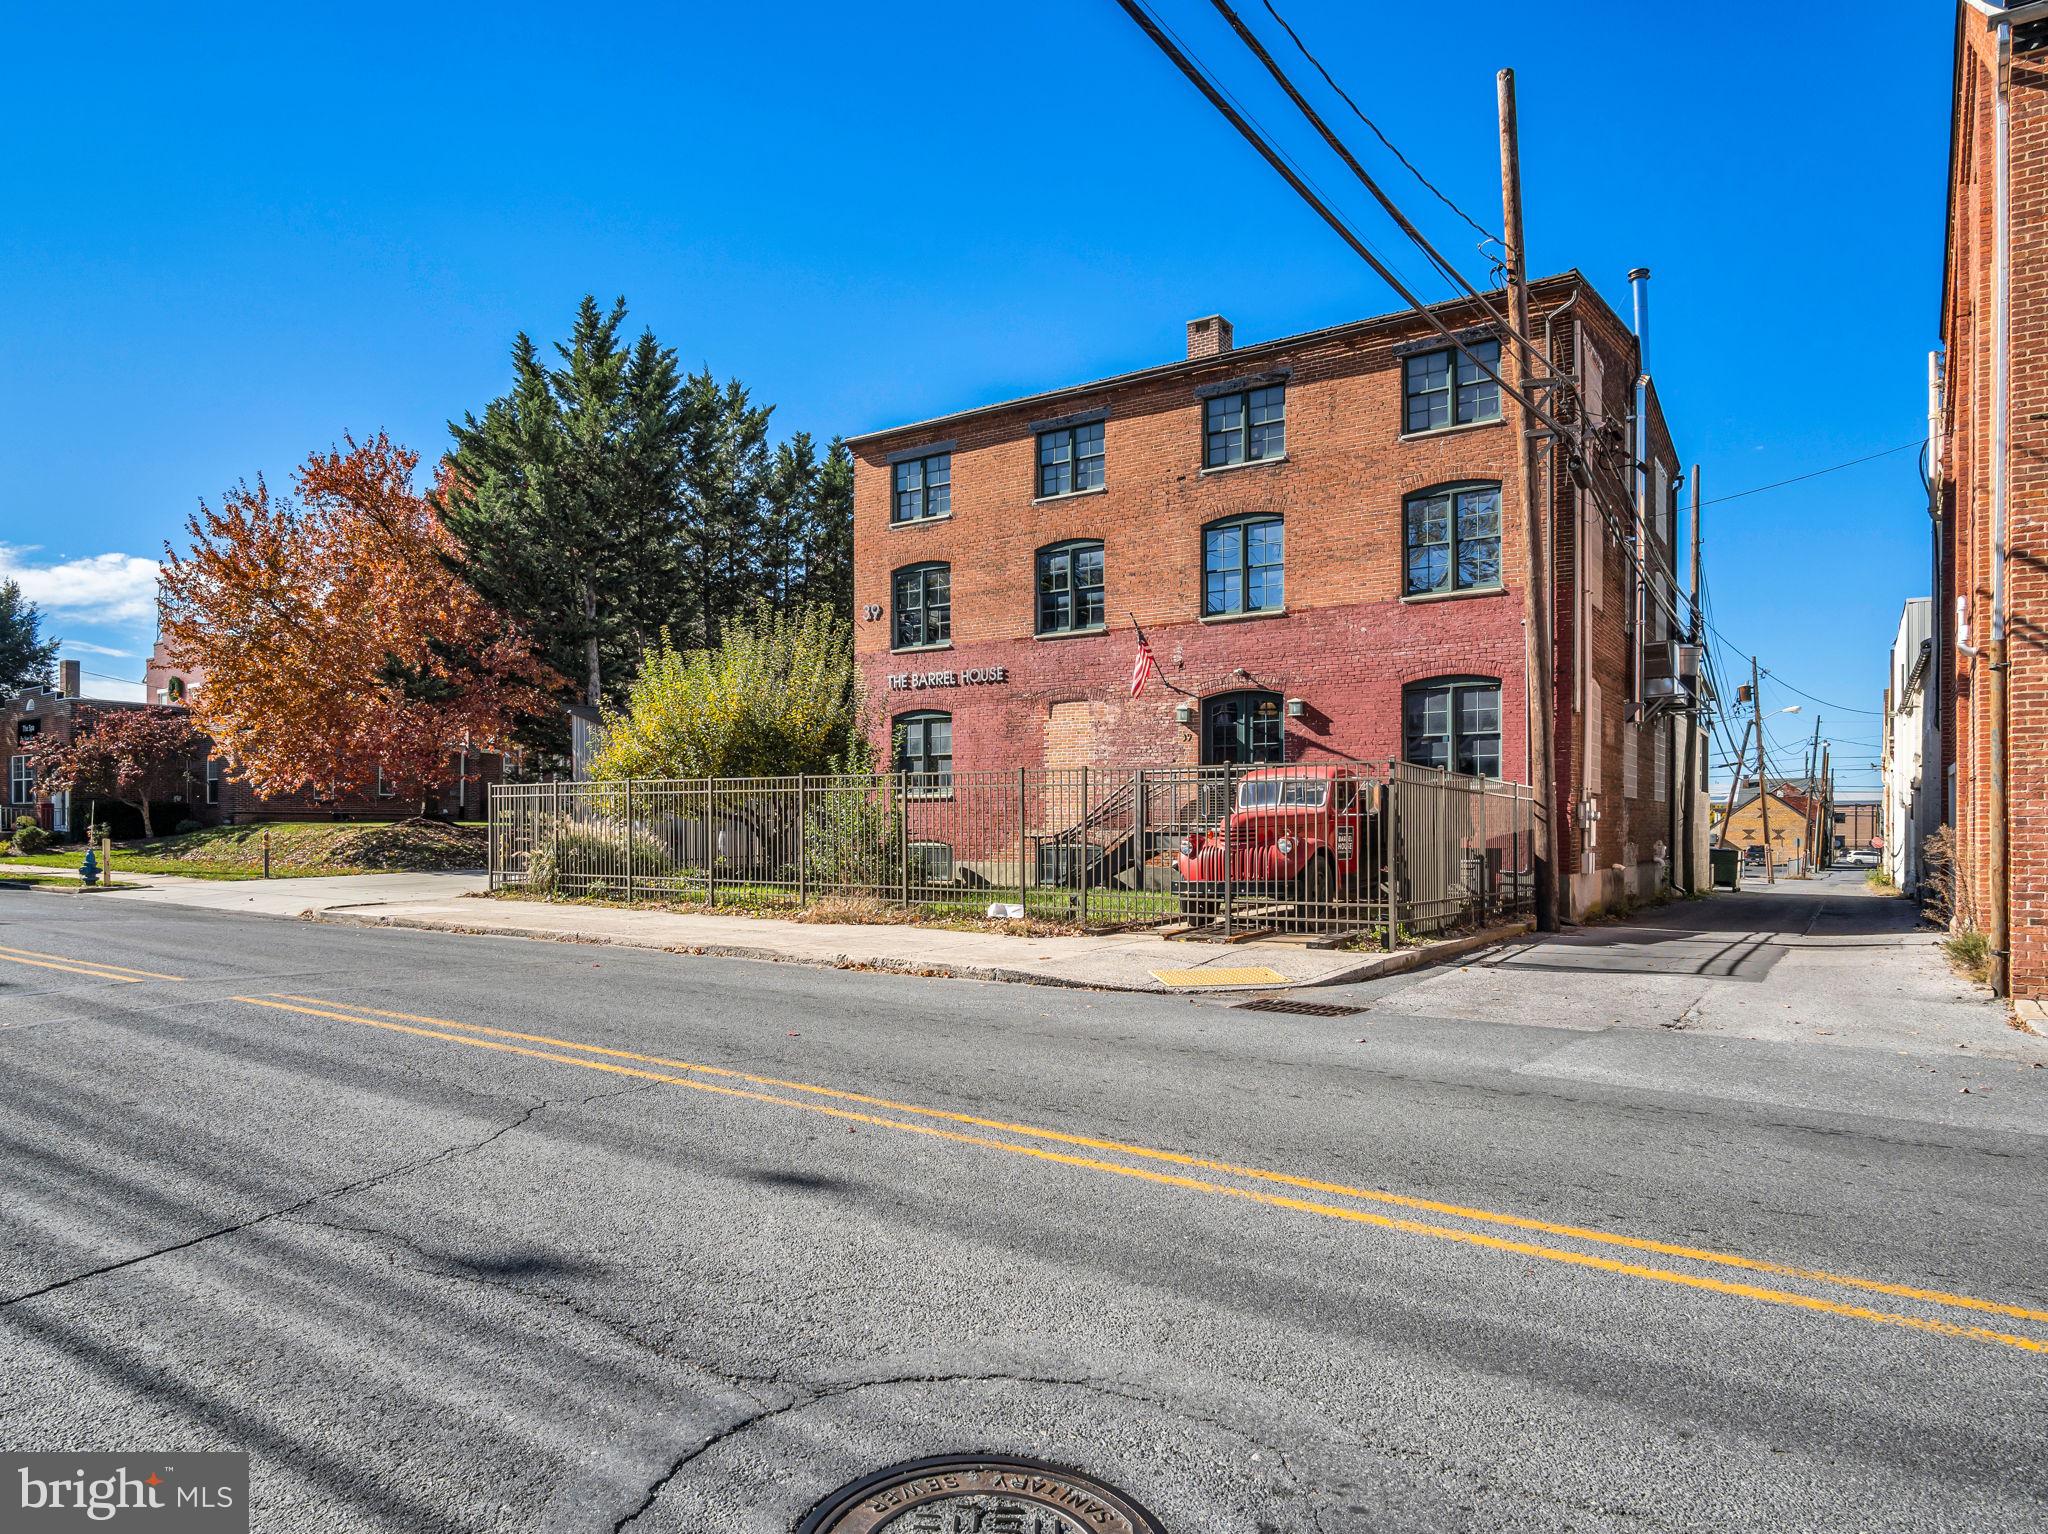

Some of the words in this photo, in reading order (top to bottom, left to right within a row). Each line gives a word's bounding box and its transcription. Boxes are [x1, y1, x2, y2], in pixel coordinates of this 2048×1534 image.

[862, 603, 880, 621] 39
[886, 673, 908, 689] THE
[911, 670, 956, 688] BARREL
[960, 666, 1004, 684] HOUSE
[863, 1476, 960, 1512] SEWER
[993, 1475, 1114, 1524] SANITARY
